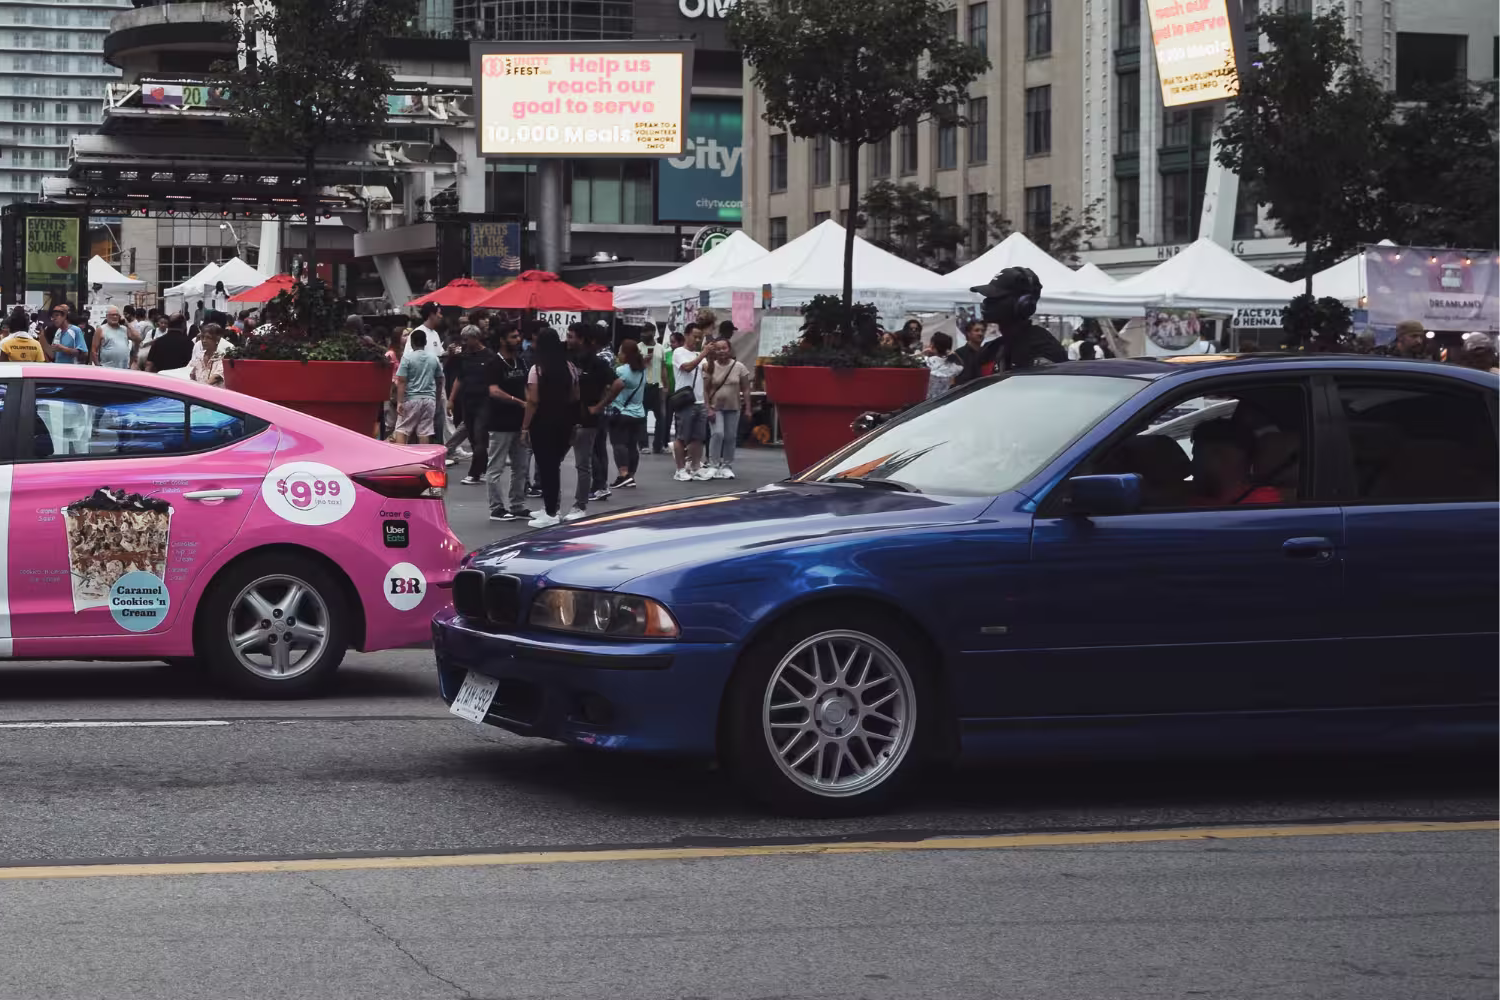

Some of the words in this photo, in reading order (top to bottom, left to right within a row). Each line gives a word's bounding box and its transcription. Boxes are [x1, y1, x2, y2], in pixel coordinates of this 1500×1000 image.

[513, 56, 549, 66] UNITY
[514, 66, 540, 76] FEST
[569, 57, 619, 79] Help
[624, 59, 651, 73] us
[547, 77, 611, 94] reach
[617, 80, 655, 94] our
[183, 87, 201, 105] 20
[512, 98, 561, 119] goal
[565, 99, 588, 113] to
[593, 101, 655, 114] serve
[564, 125, 632, 143] Meals
[667, 136, 743, 177] City
[28, 219, 67, 230] EVENTS
[473, 224, 508, 235] EVENTS
[28, 230, 40, 241] AT
[43, 230, 63, 241] THE
[473, 235, 484, 247] AT
[488, 235, 505, 247] THE
[28, 242, 67, 253] SQUARE
[473, 246, 509, 257] SQUARE
[1429, 299, 1483, 309] DREAMLAND
[1237, 308, 1263, 317] FACE
[539, 313, 562, 326] BAR
[565, 314, 577, 325] IS
[1243, 317, 1277, 326] HENNA
[386, 526, 406, 534] Uber
[387, 534, 406, 542] Eats
[116, 586, 162, 595] Caramel
[112, 597, 154, 606] Cookies
[122, 608, 157, 617] Cream
